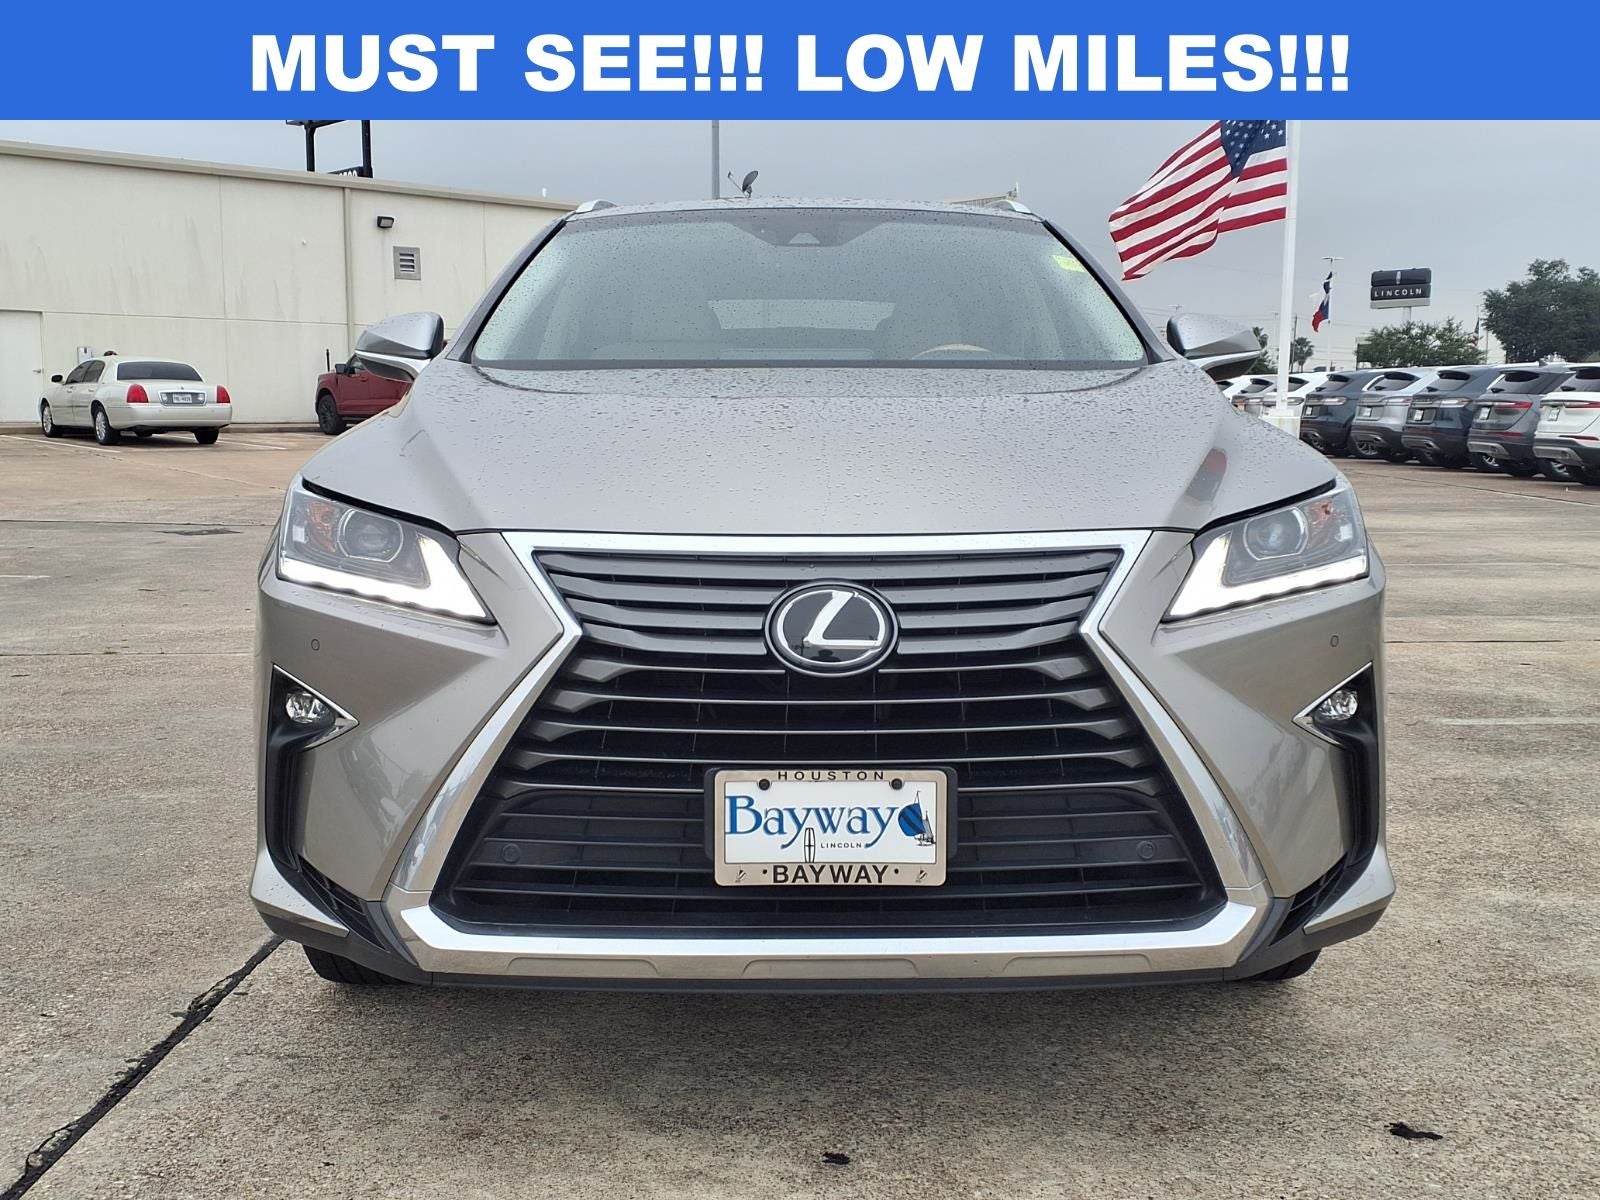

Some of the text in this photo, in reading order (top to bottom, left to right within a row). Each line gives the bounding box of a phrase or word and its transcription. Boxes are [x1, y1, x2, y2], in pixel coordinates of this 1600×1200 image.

[1374, 288, 1422, 297] LINCOLN
[777, 771, 885, 781] HOUSTON
[725, 795, 899, 849] Bayway
[772, 864, 889, 884] BAYWAY
